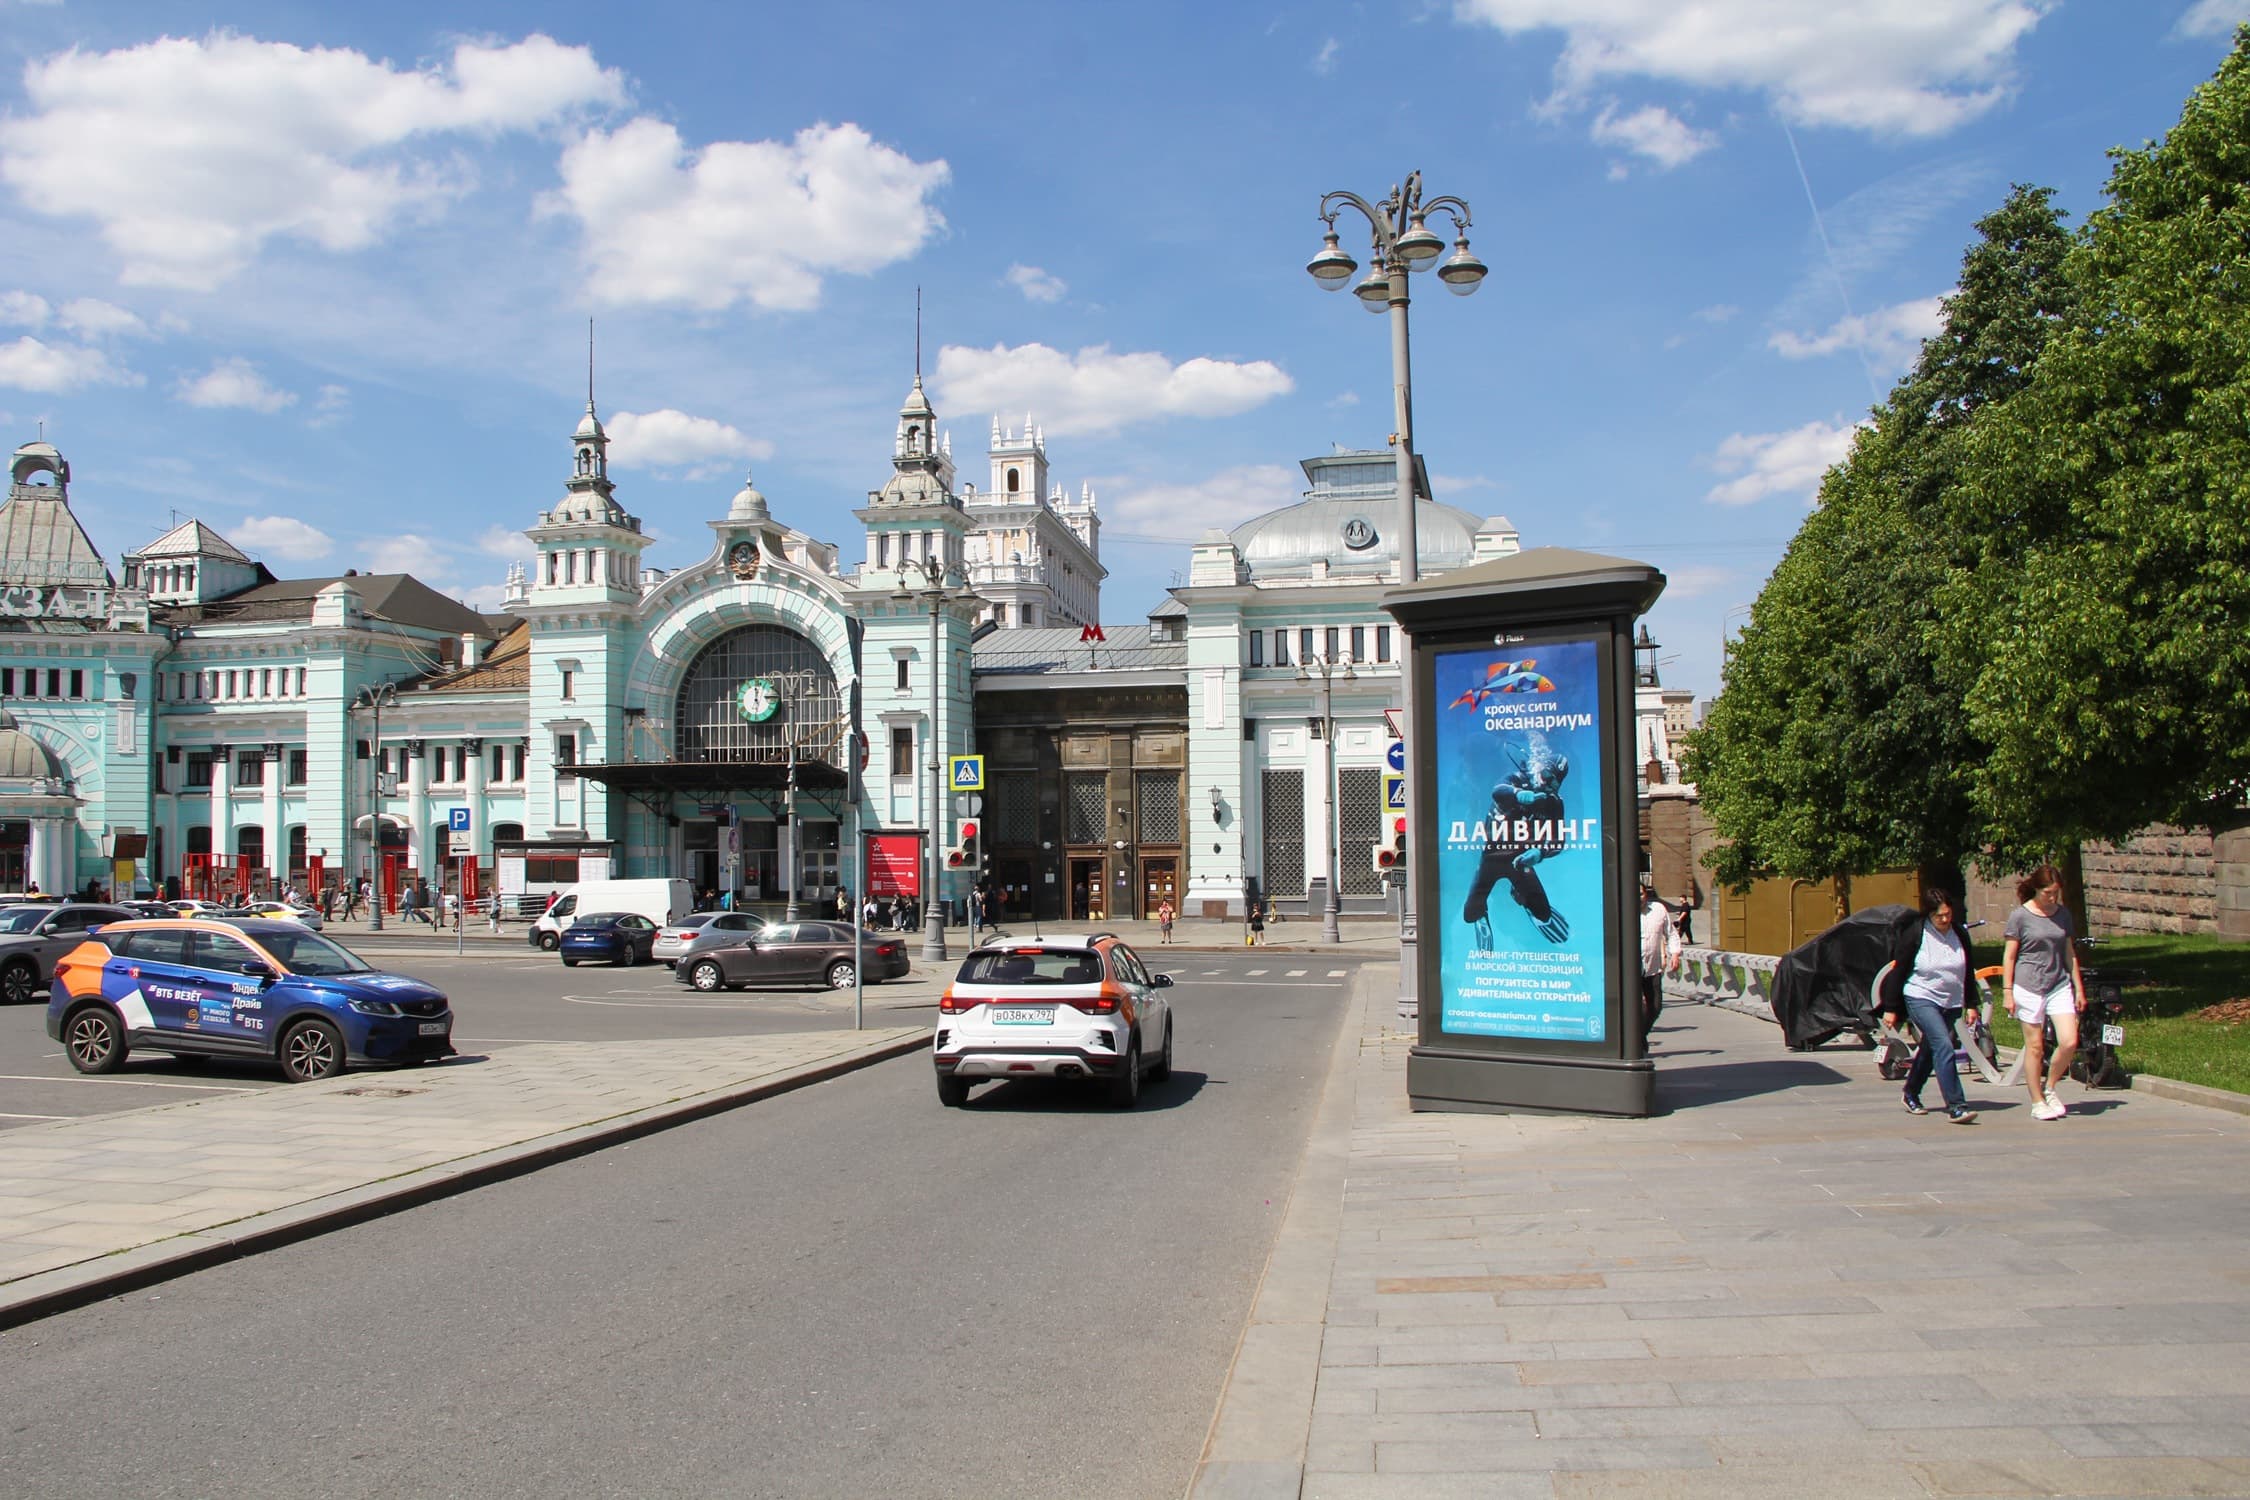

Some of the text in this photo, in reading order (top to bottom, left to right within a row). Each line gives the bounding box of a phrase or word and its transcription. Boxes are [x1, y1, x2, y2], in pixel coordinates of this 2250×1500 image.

[1484, 702, 1557, 716] крокус сити
[1485, 714, 1592, 731] океанариум
[1448, 815, 1597, 842] ДАЙВИНГ
[1468, 949, 1580, 962] ДАЙВИНГ-ПУТЕШЕСТВИЯ
[1465, 962, 1584, 975] В МОРСКОЙ ЭКСПОЗИЦИИ
[231, 983, 265, 995] Яндекс
[1476, 977, 1571, 989] ПОГРУЗИТЕСЬ В МИР
[156, 987, 202, 1002] ВТБ ВЕЗЁТ
[1457, 987, 1591, 1003] УДИВИТЕЛЬНЫХ ОТКРЫТИЙ!
[232, 997, 262, 1009] Драйв
[1448, 1010, 1536, 1021] crocus-oceanarium.ru
[244, 1018, 263, 1030] ВТБ
